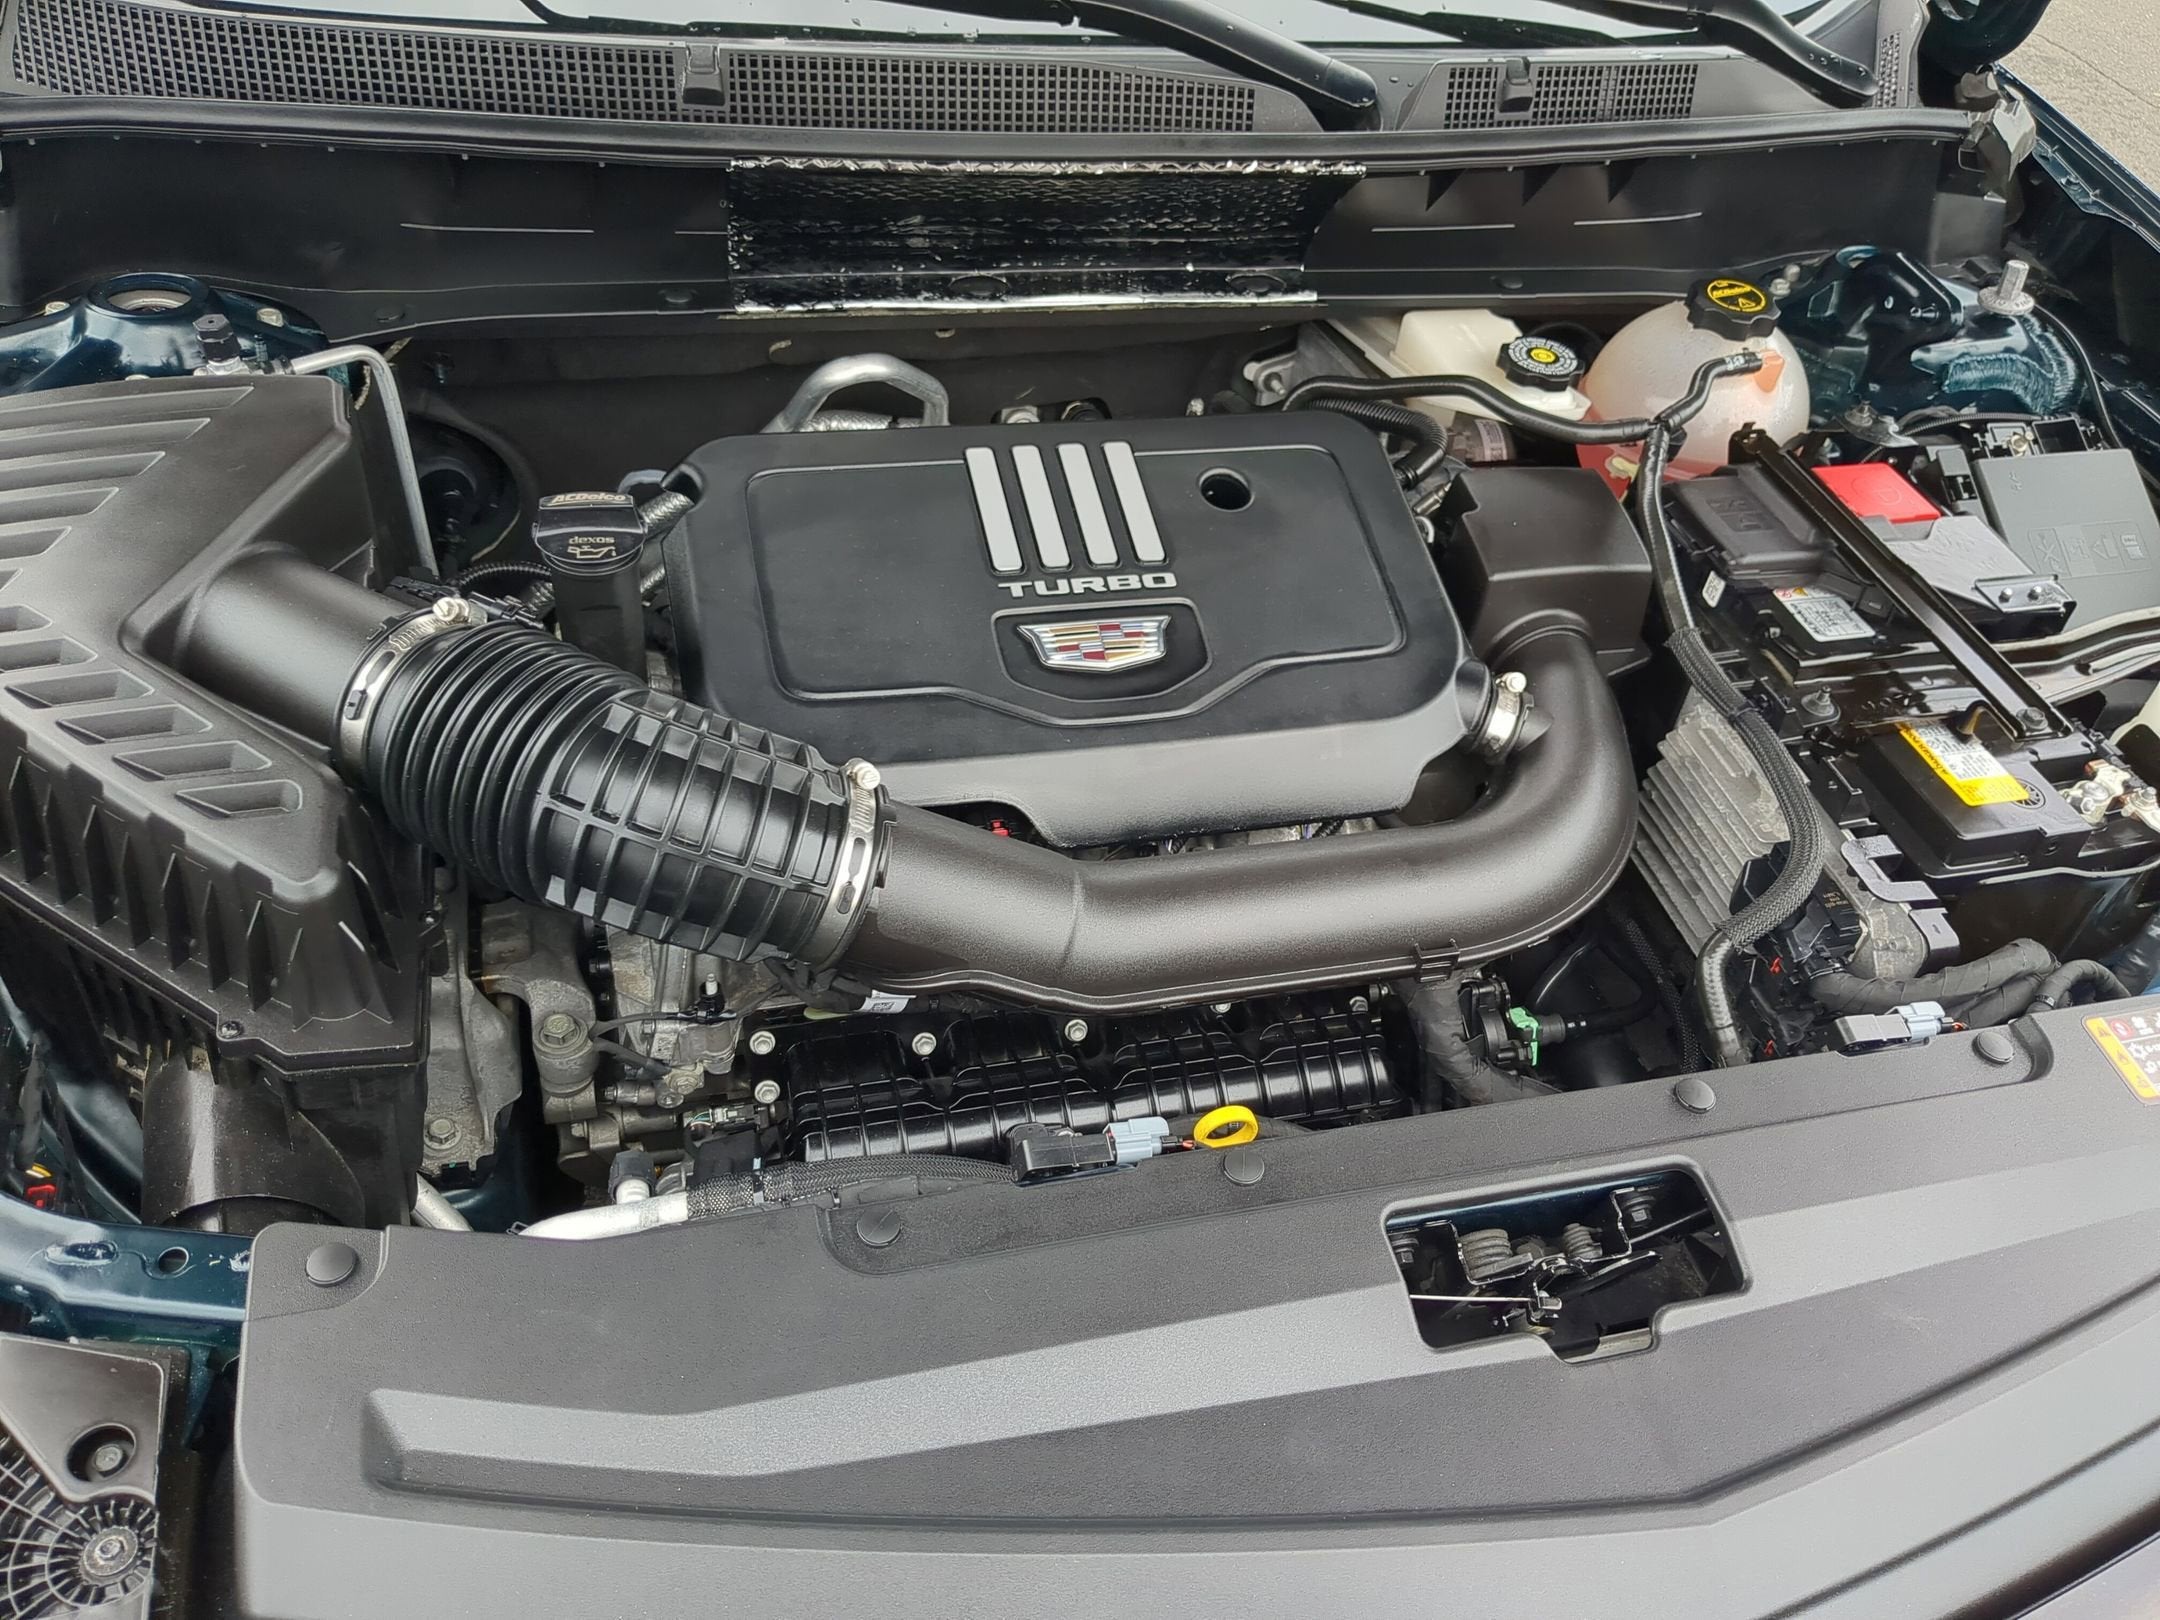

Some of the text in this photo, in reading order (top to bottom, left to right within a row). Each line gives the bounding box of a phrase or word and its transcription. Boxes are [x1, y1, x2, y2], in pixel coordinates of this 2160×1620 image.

[551, 493, 627, 504] ACDelco
[568, 536, 616, 545] dexos
[998, 572, 1178, 598] TURBO
